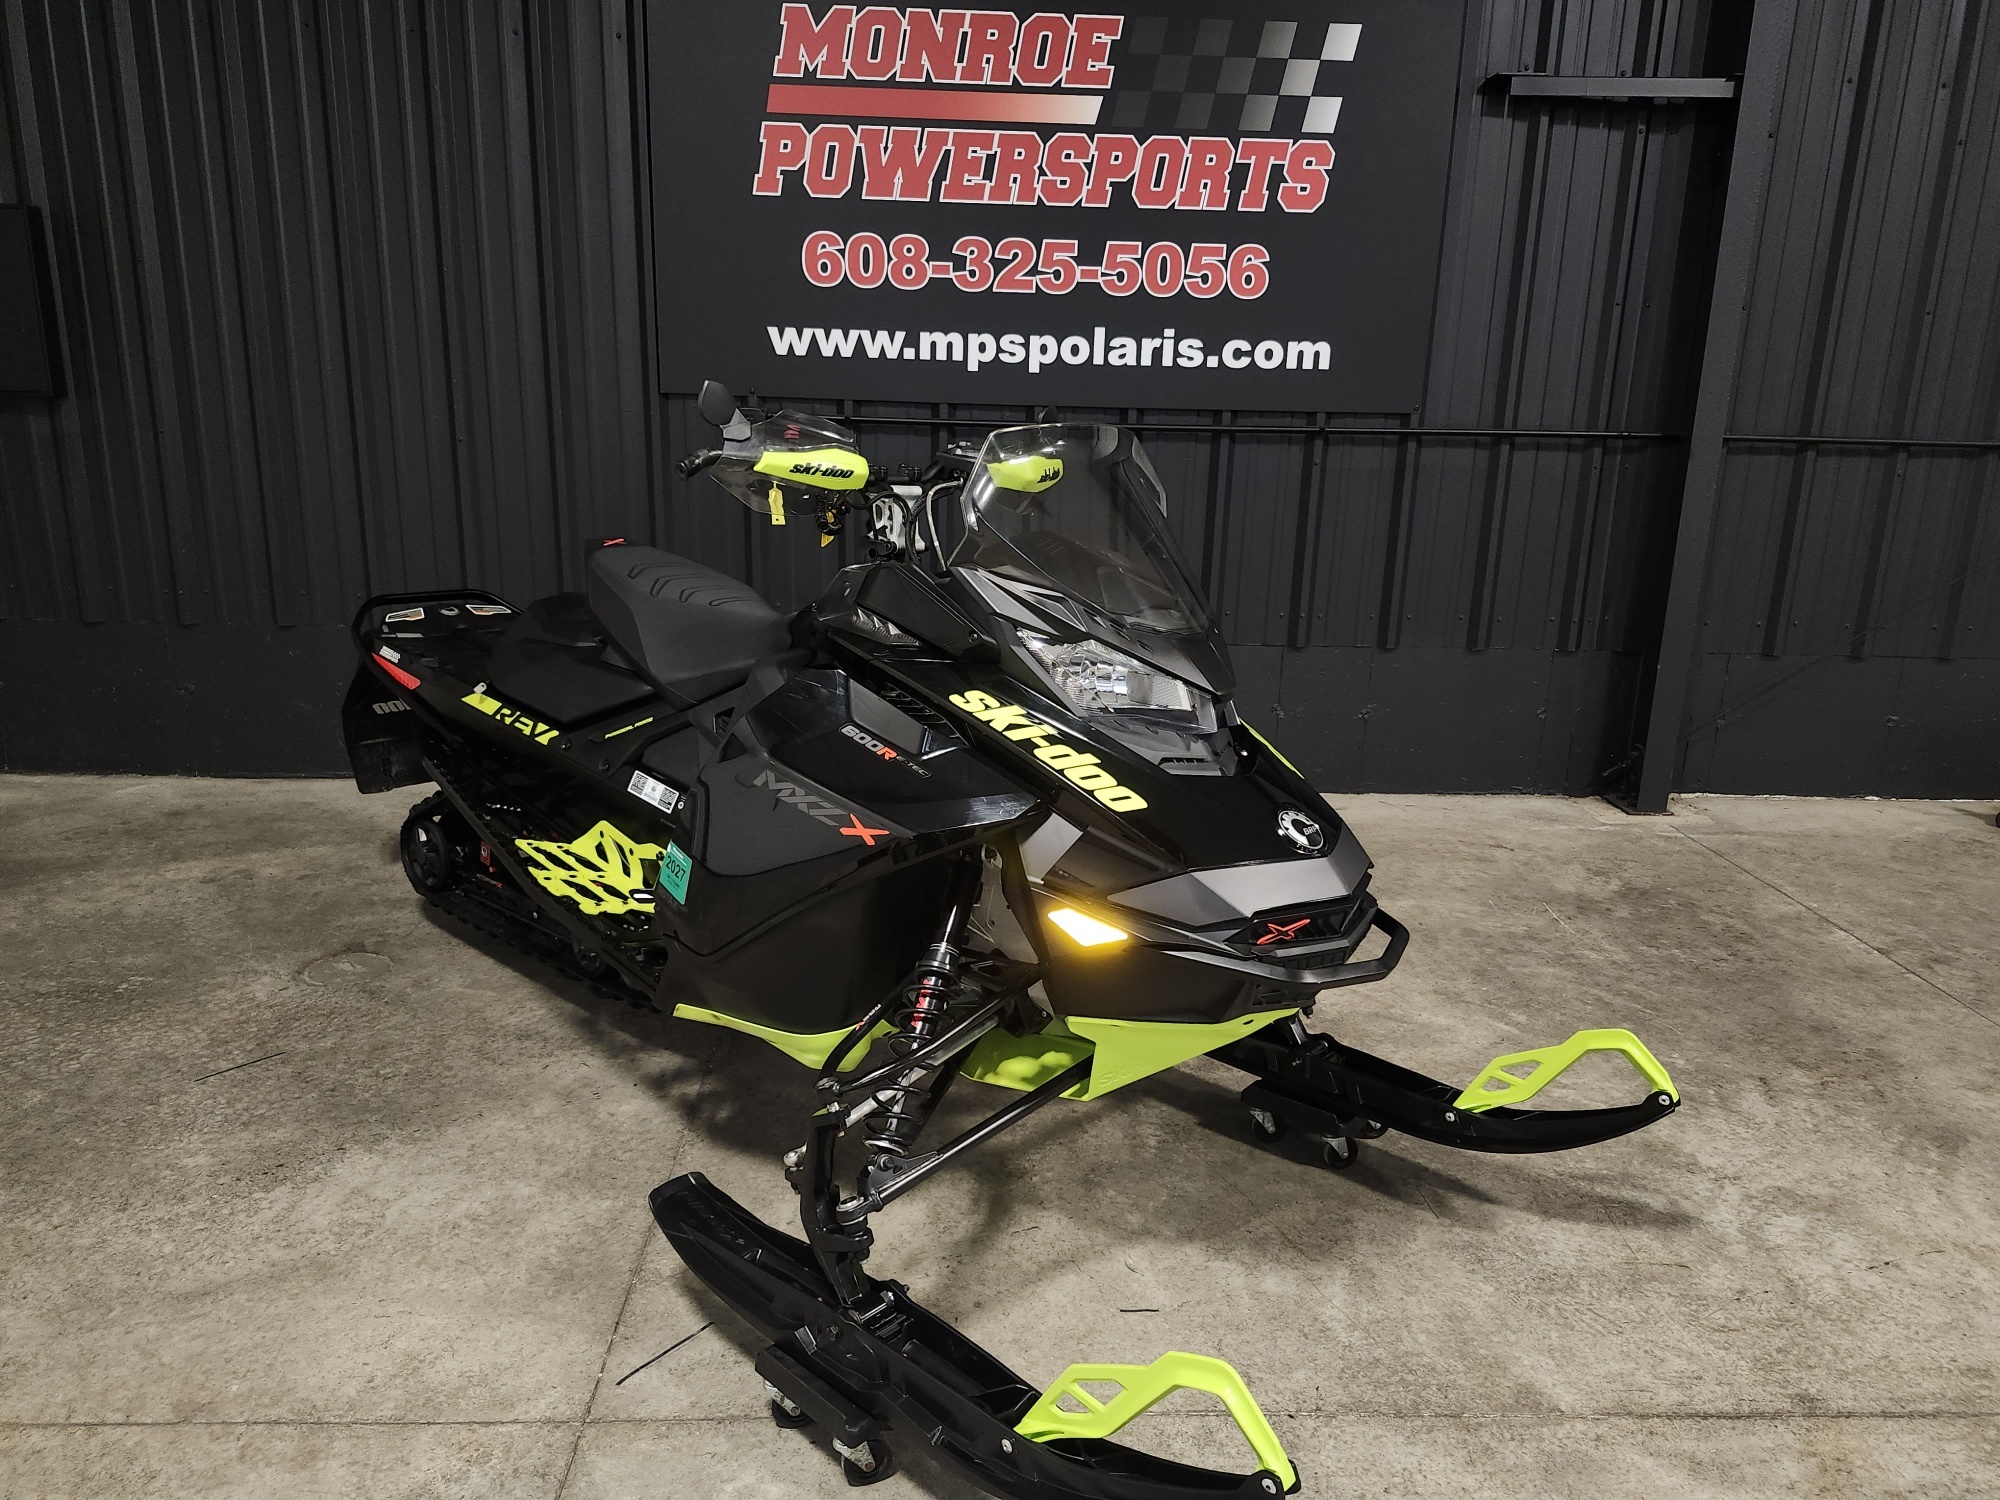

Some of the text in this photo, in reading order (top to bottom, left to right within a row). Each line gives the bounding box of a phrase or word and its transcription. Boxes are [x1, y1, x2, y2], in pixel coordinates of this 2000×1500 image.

[773, 3, 1124, 88] MONROE
[753, 121, 1335, 212] POWERSPORTS
[802, 230, 1270, 299] 608-325-5056
[768, 325, 1332, 373] www.mpspolaris.com
[789, 463, 855, 478] ski-doo
[949, 690, 1148, 813] ski-doo
[1303, 825, 1318, 836] BRP
[666, 855, 687, 882] 2027
